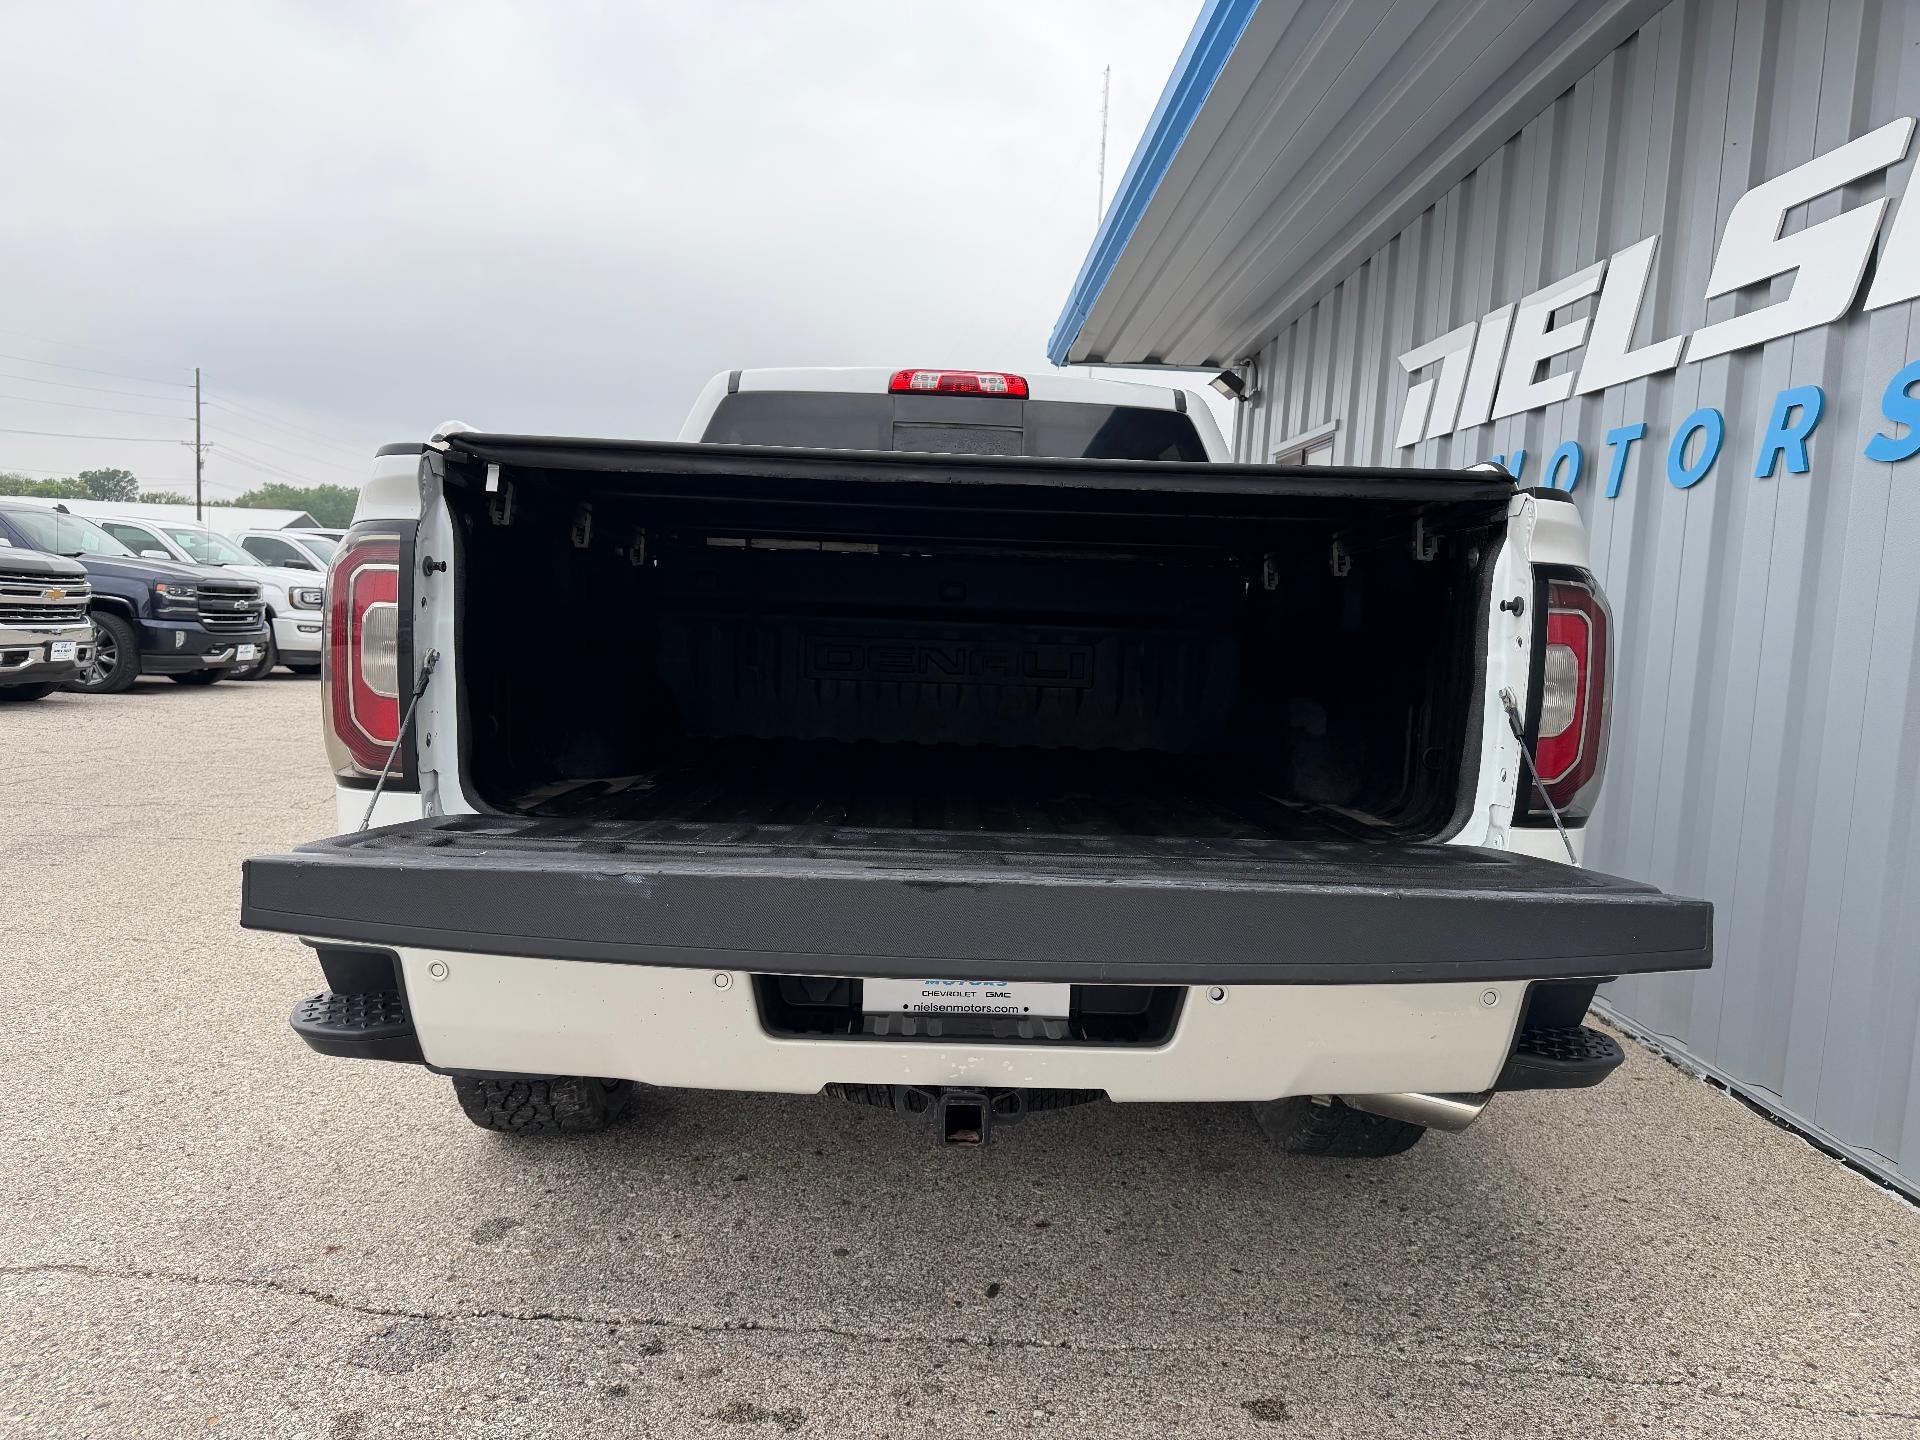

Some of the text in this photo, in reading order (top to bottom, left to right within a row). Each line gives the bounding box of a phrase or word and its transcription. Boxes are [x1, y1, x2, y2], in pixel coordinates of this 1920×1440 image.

[1395, 116, 1920, 449] NIELS
[813, 643, 1089, 681] DENALI
[921, 990, 977, 998] CHEVROLET
[913, 1002, 1019, 1014] nielsenmotors.com
